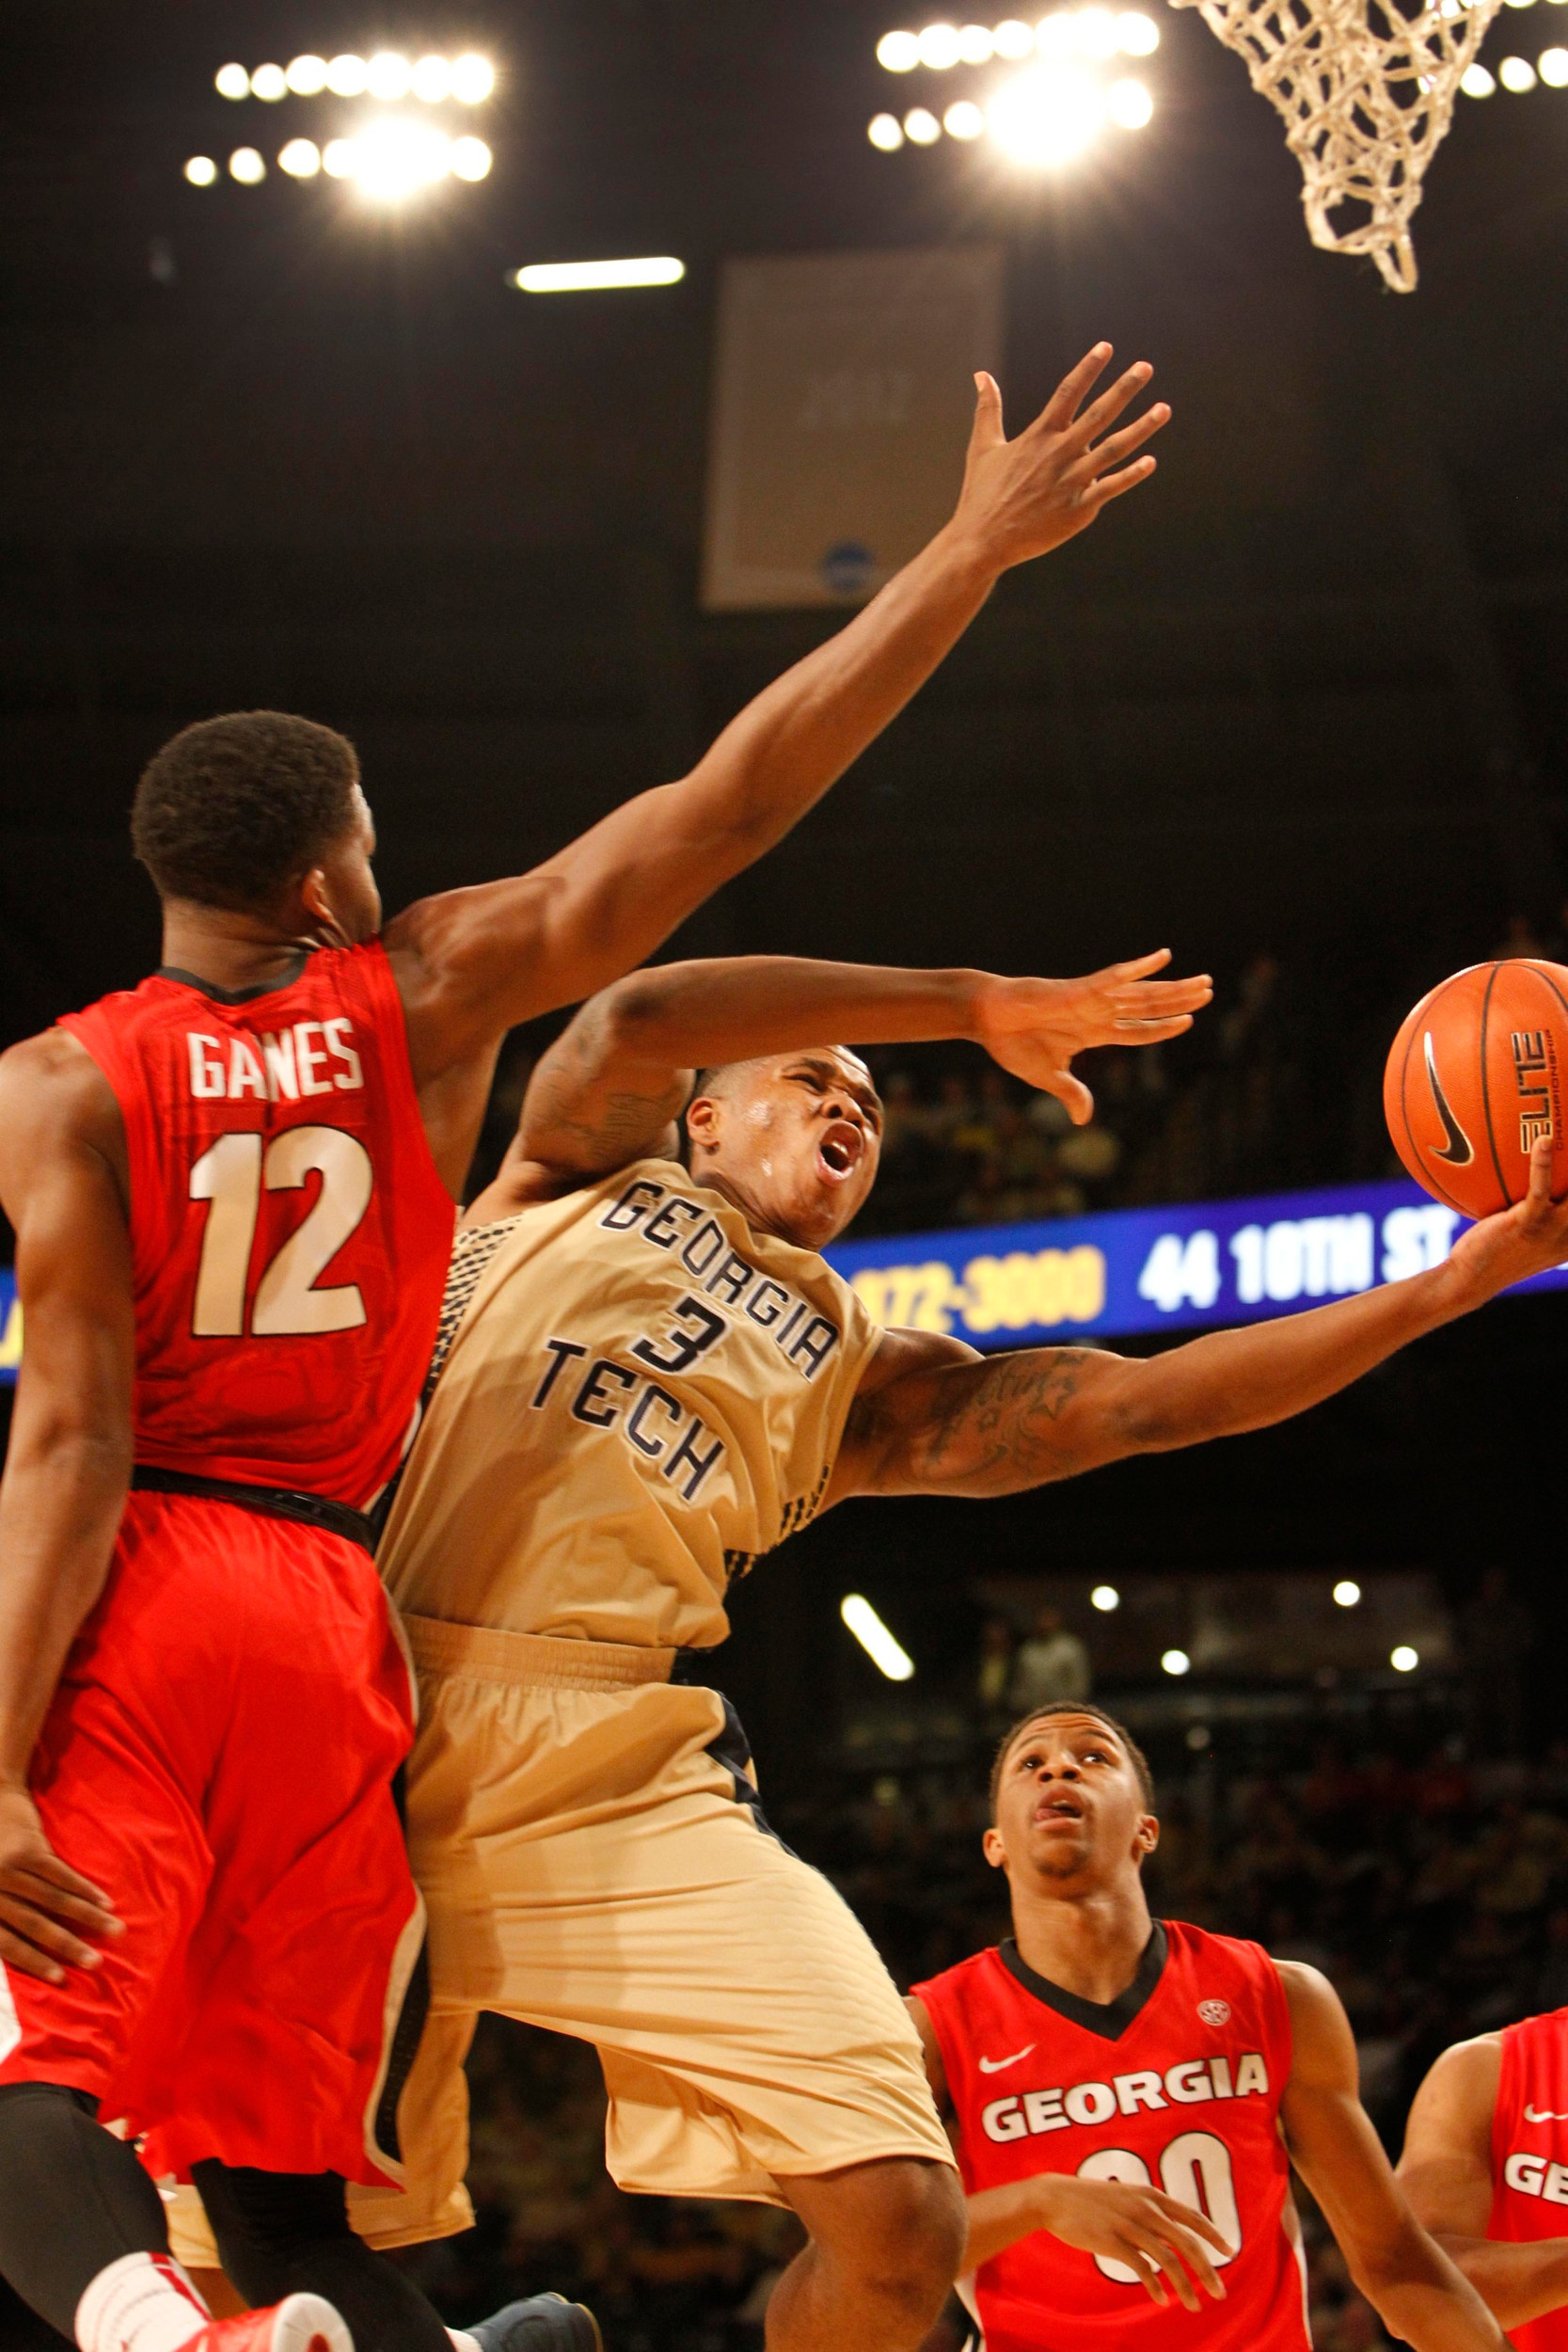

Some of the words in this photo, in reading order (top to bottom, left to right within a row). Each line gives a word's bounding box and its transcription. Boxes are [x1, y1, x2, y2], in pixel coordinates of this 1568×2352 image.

[186, 1017, 364, 1102] GANES
[189, 1122, 373, 1338] 12
[1138, 1230, 1220, 1312] 44
[601, 1180, 840, 1383] GEORGIA
[627, 1291, 732, 1376] 3
[530, 1337, 726, 1502] TECH
[981, 2053, 1269, 2143] GEORGIA
